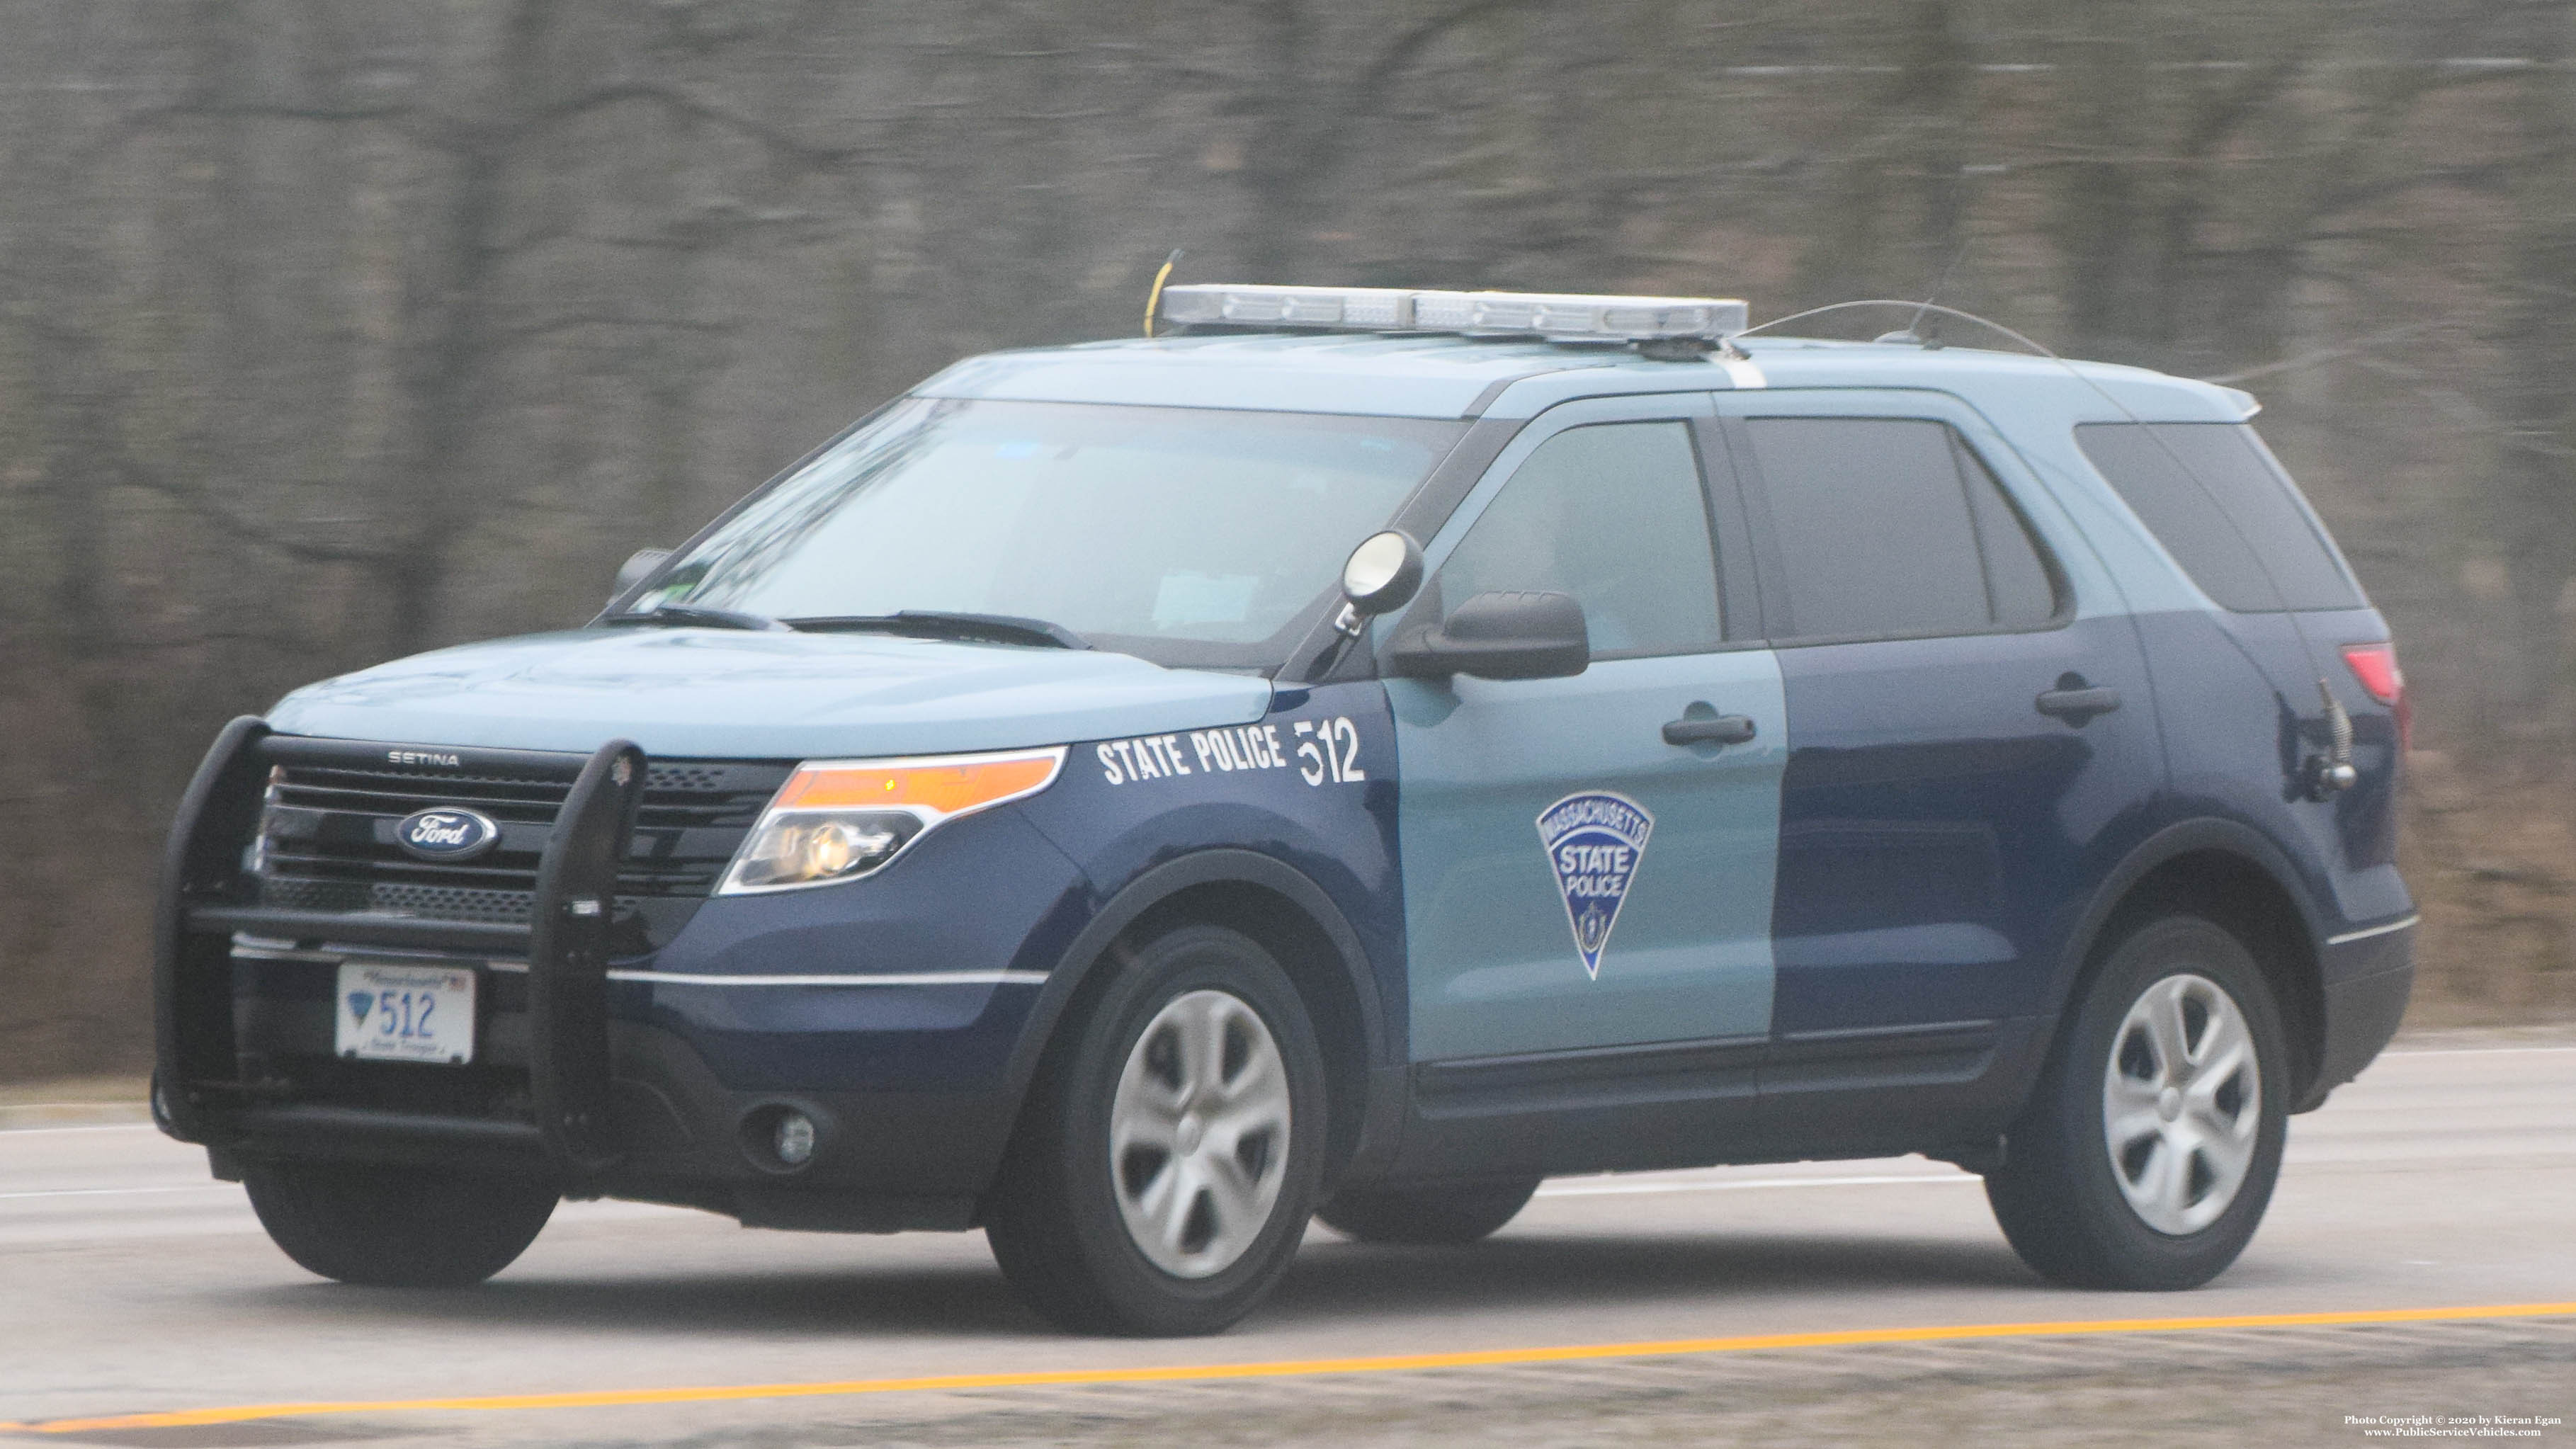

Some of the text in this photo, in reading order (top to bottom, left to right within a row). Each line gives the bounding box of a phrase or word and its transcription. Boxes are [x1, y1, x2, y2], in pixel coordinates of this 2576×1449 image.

[389, 751, 460, 766] SETINA
[1097, 717, 1366, 787] STATE POLICE 512
[410, 814, 470, 845] Ford
[1560, 845, 1630, 874] STATE
[1566, 874, 1623, 897] POLICE
[380, 991, 436, 1038] 512
